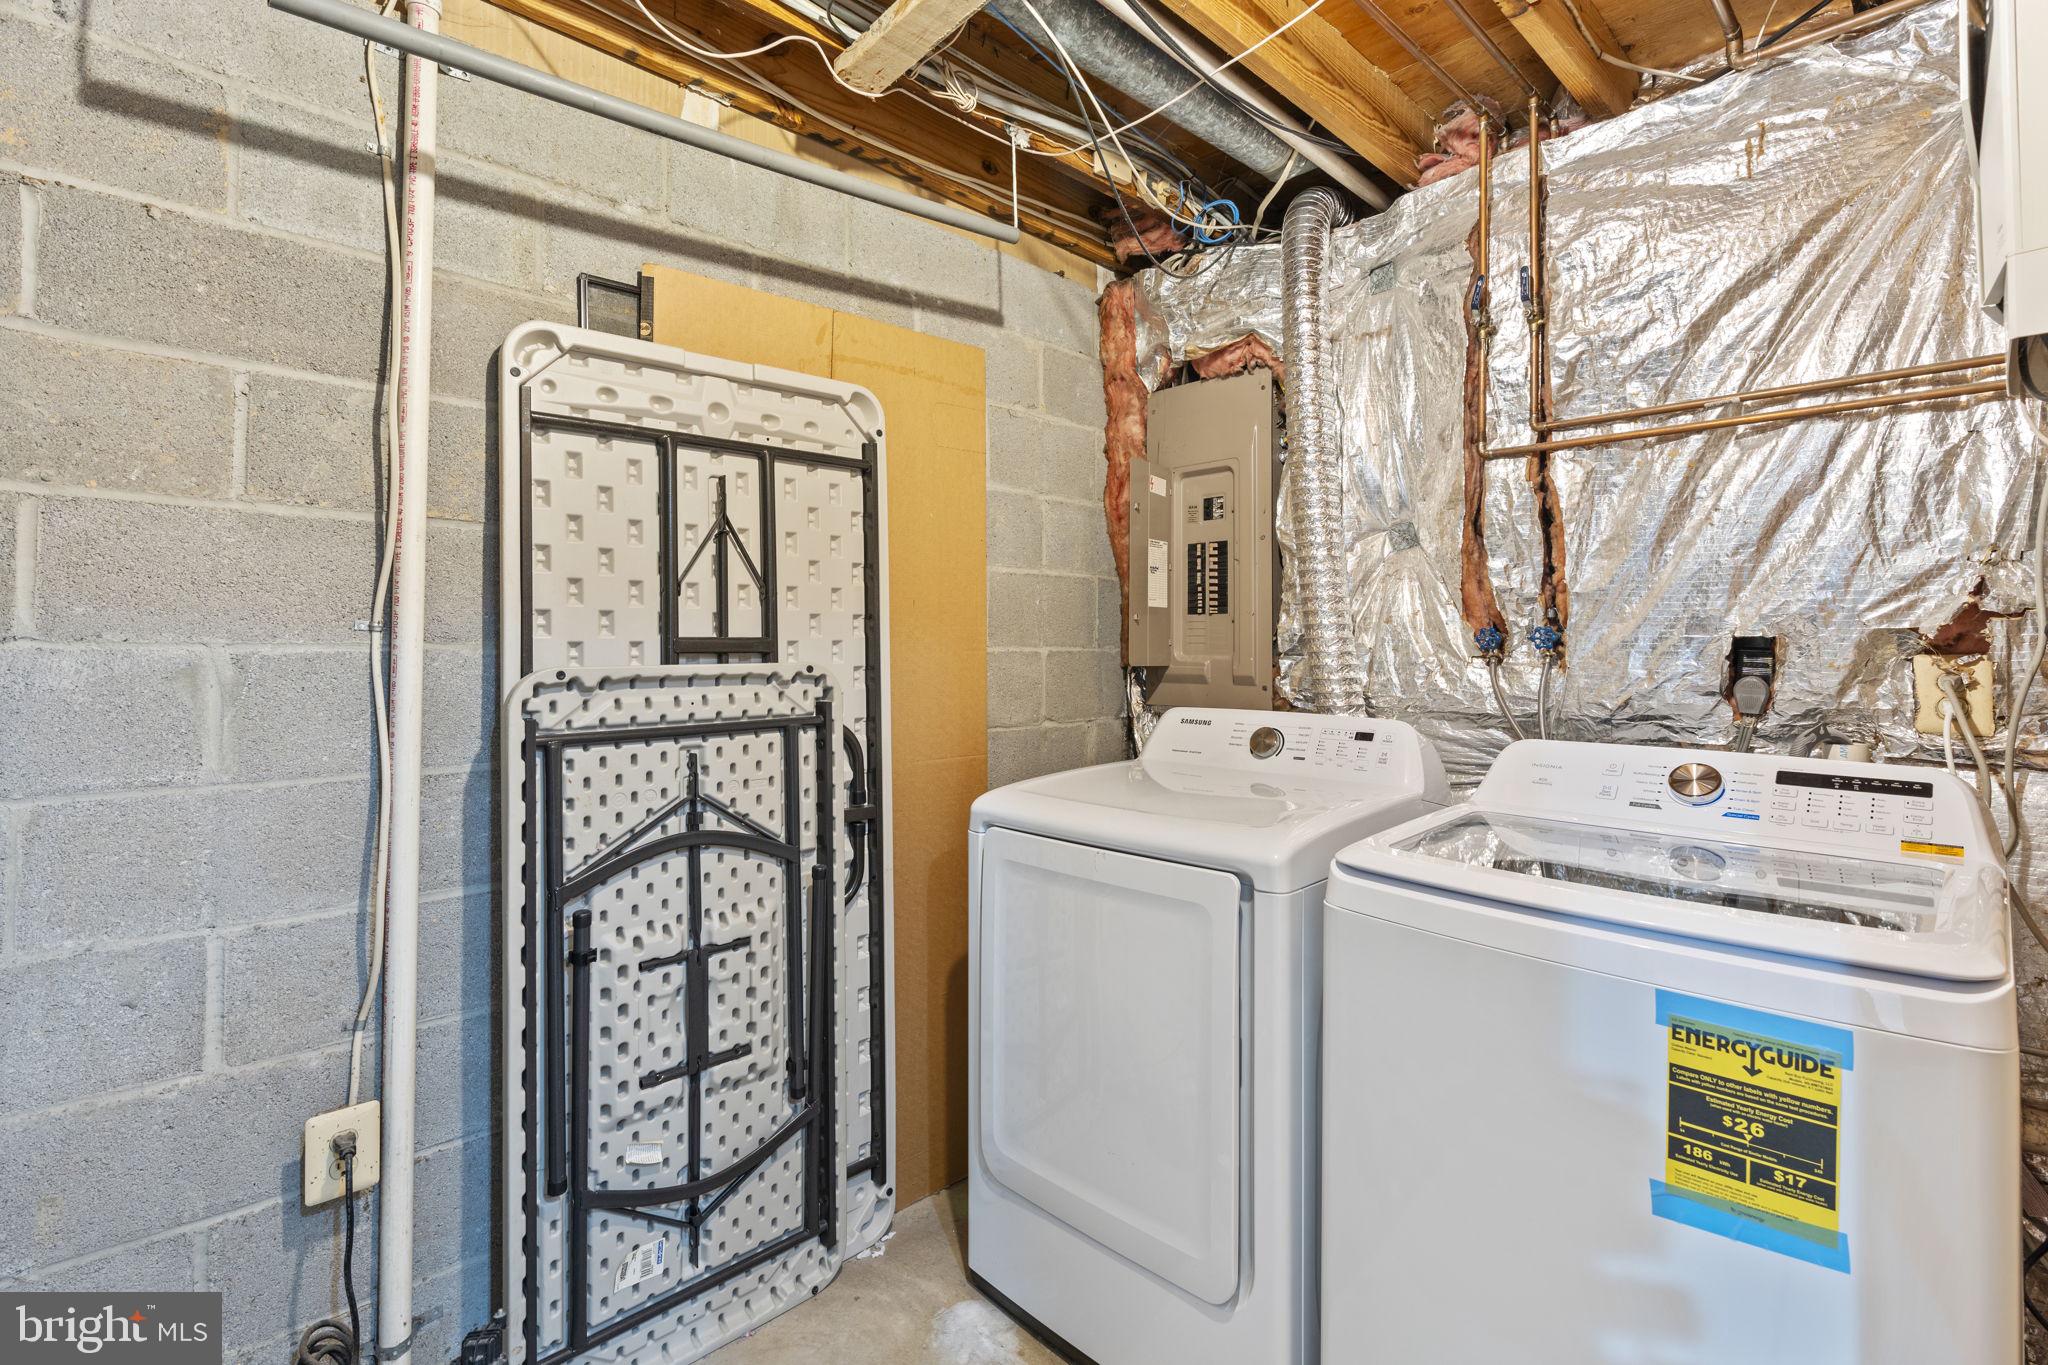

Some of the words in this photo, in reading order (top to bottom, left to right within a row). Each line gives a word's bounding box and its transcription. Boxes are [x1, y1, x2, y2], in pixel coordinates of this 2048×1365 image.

[1180, 718, 1212, 726] SAMSUNG
[1672, 1023, 1835, 1080] ENERGYGUIDE
[1672, 1066, 1699, 1080] Compare
[1700, 1074, 1717, 1084] ONLY
[1725, 1081, 1742, 1090] other
[1743, 1086, 1763, 1096] labels
[1763, 1091, 1778, 1100] with
[1778, 1095, 1801, 1108] yellow
[1801, 1101, 1834, 1115] numbers.
[1705, 1095, 1734, 1109] Estimated
[1736, 1103, 1754, 1115] Yearly
[1755, 1109, 1777, 1122] Energy
[1778, 1115, 1794, 1125] Cost
[1722, 1114, 1765, 1138] $26
[1683, 1143, 1713, 1161] 186
[1773, 1170, 1807, 1189] $17
